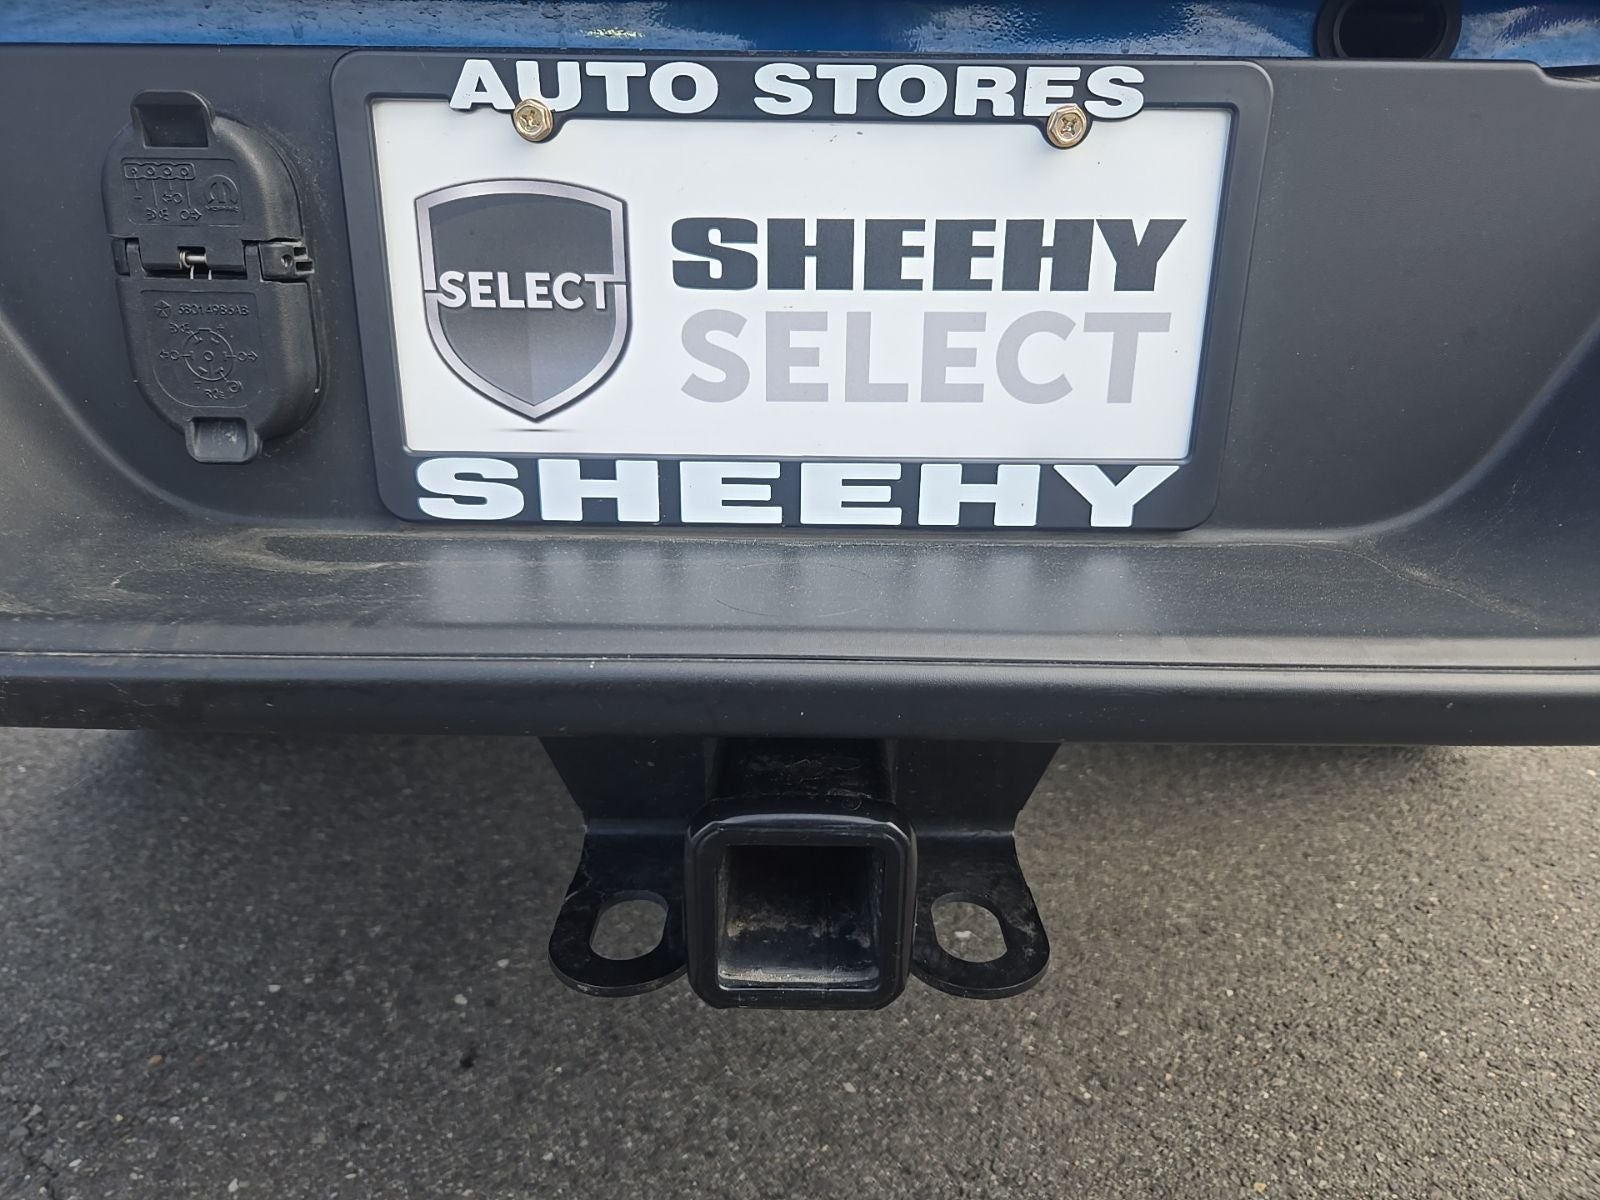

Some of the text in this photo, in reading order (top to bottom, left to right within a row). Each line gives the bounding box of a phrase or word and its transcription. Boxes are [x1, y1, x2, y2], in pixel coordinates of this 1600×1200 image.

[449, 58, 1145, 120] AUTO STORES
[437, 269, 611, 311] SELECT
[670, 216, 1188, 292] SHEEHY
[680, 309, 1172, 405] SELECT
[416, 456, 1180, 528] SHEEHY
